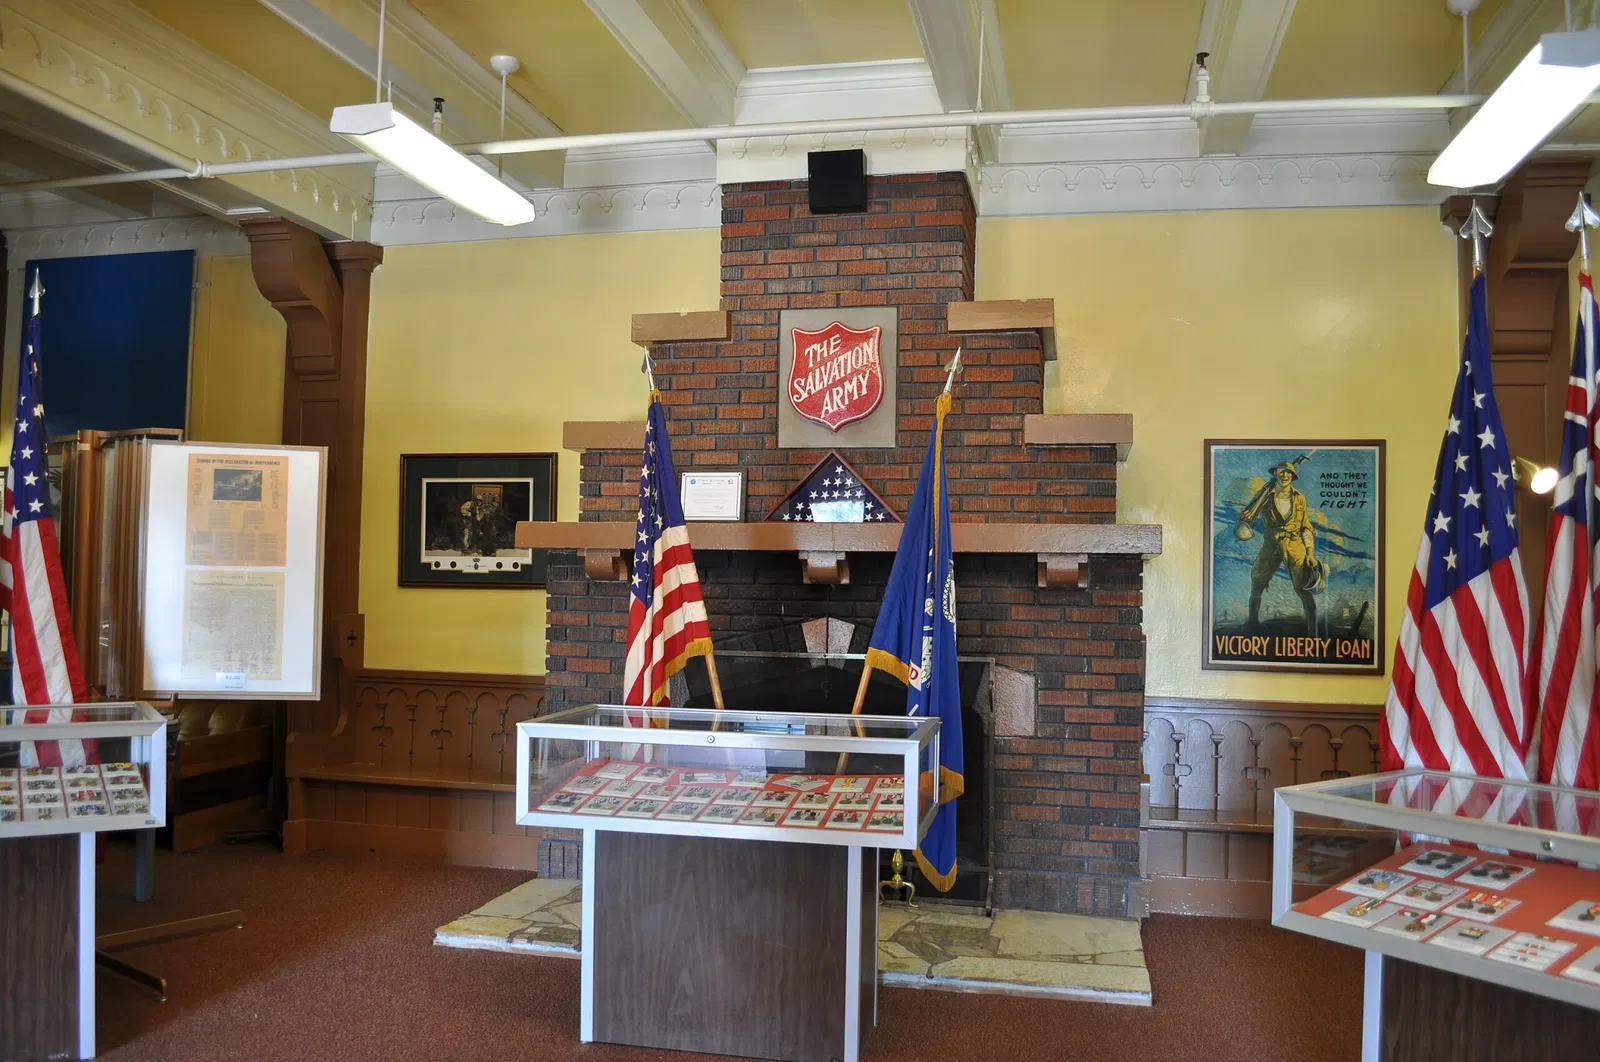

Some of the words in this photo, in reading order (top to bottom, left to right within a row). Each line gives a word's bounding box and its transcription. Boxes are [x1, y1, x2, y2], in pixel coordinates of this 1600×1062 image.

[804, 333, 841, 368] THE
[793, 337, 876, 402] SALVATION
[820, 368, 871, 419] ARMY
[1320, 490, 1367, 498] COULDN'T
[1215, 635, 1270, 656] VICTORY
[1275, 636, 1331, 658] LIBERTY
[1336, 638, 1370, 659] LOAN
